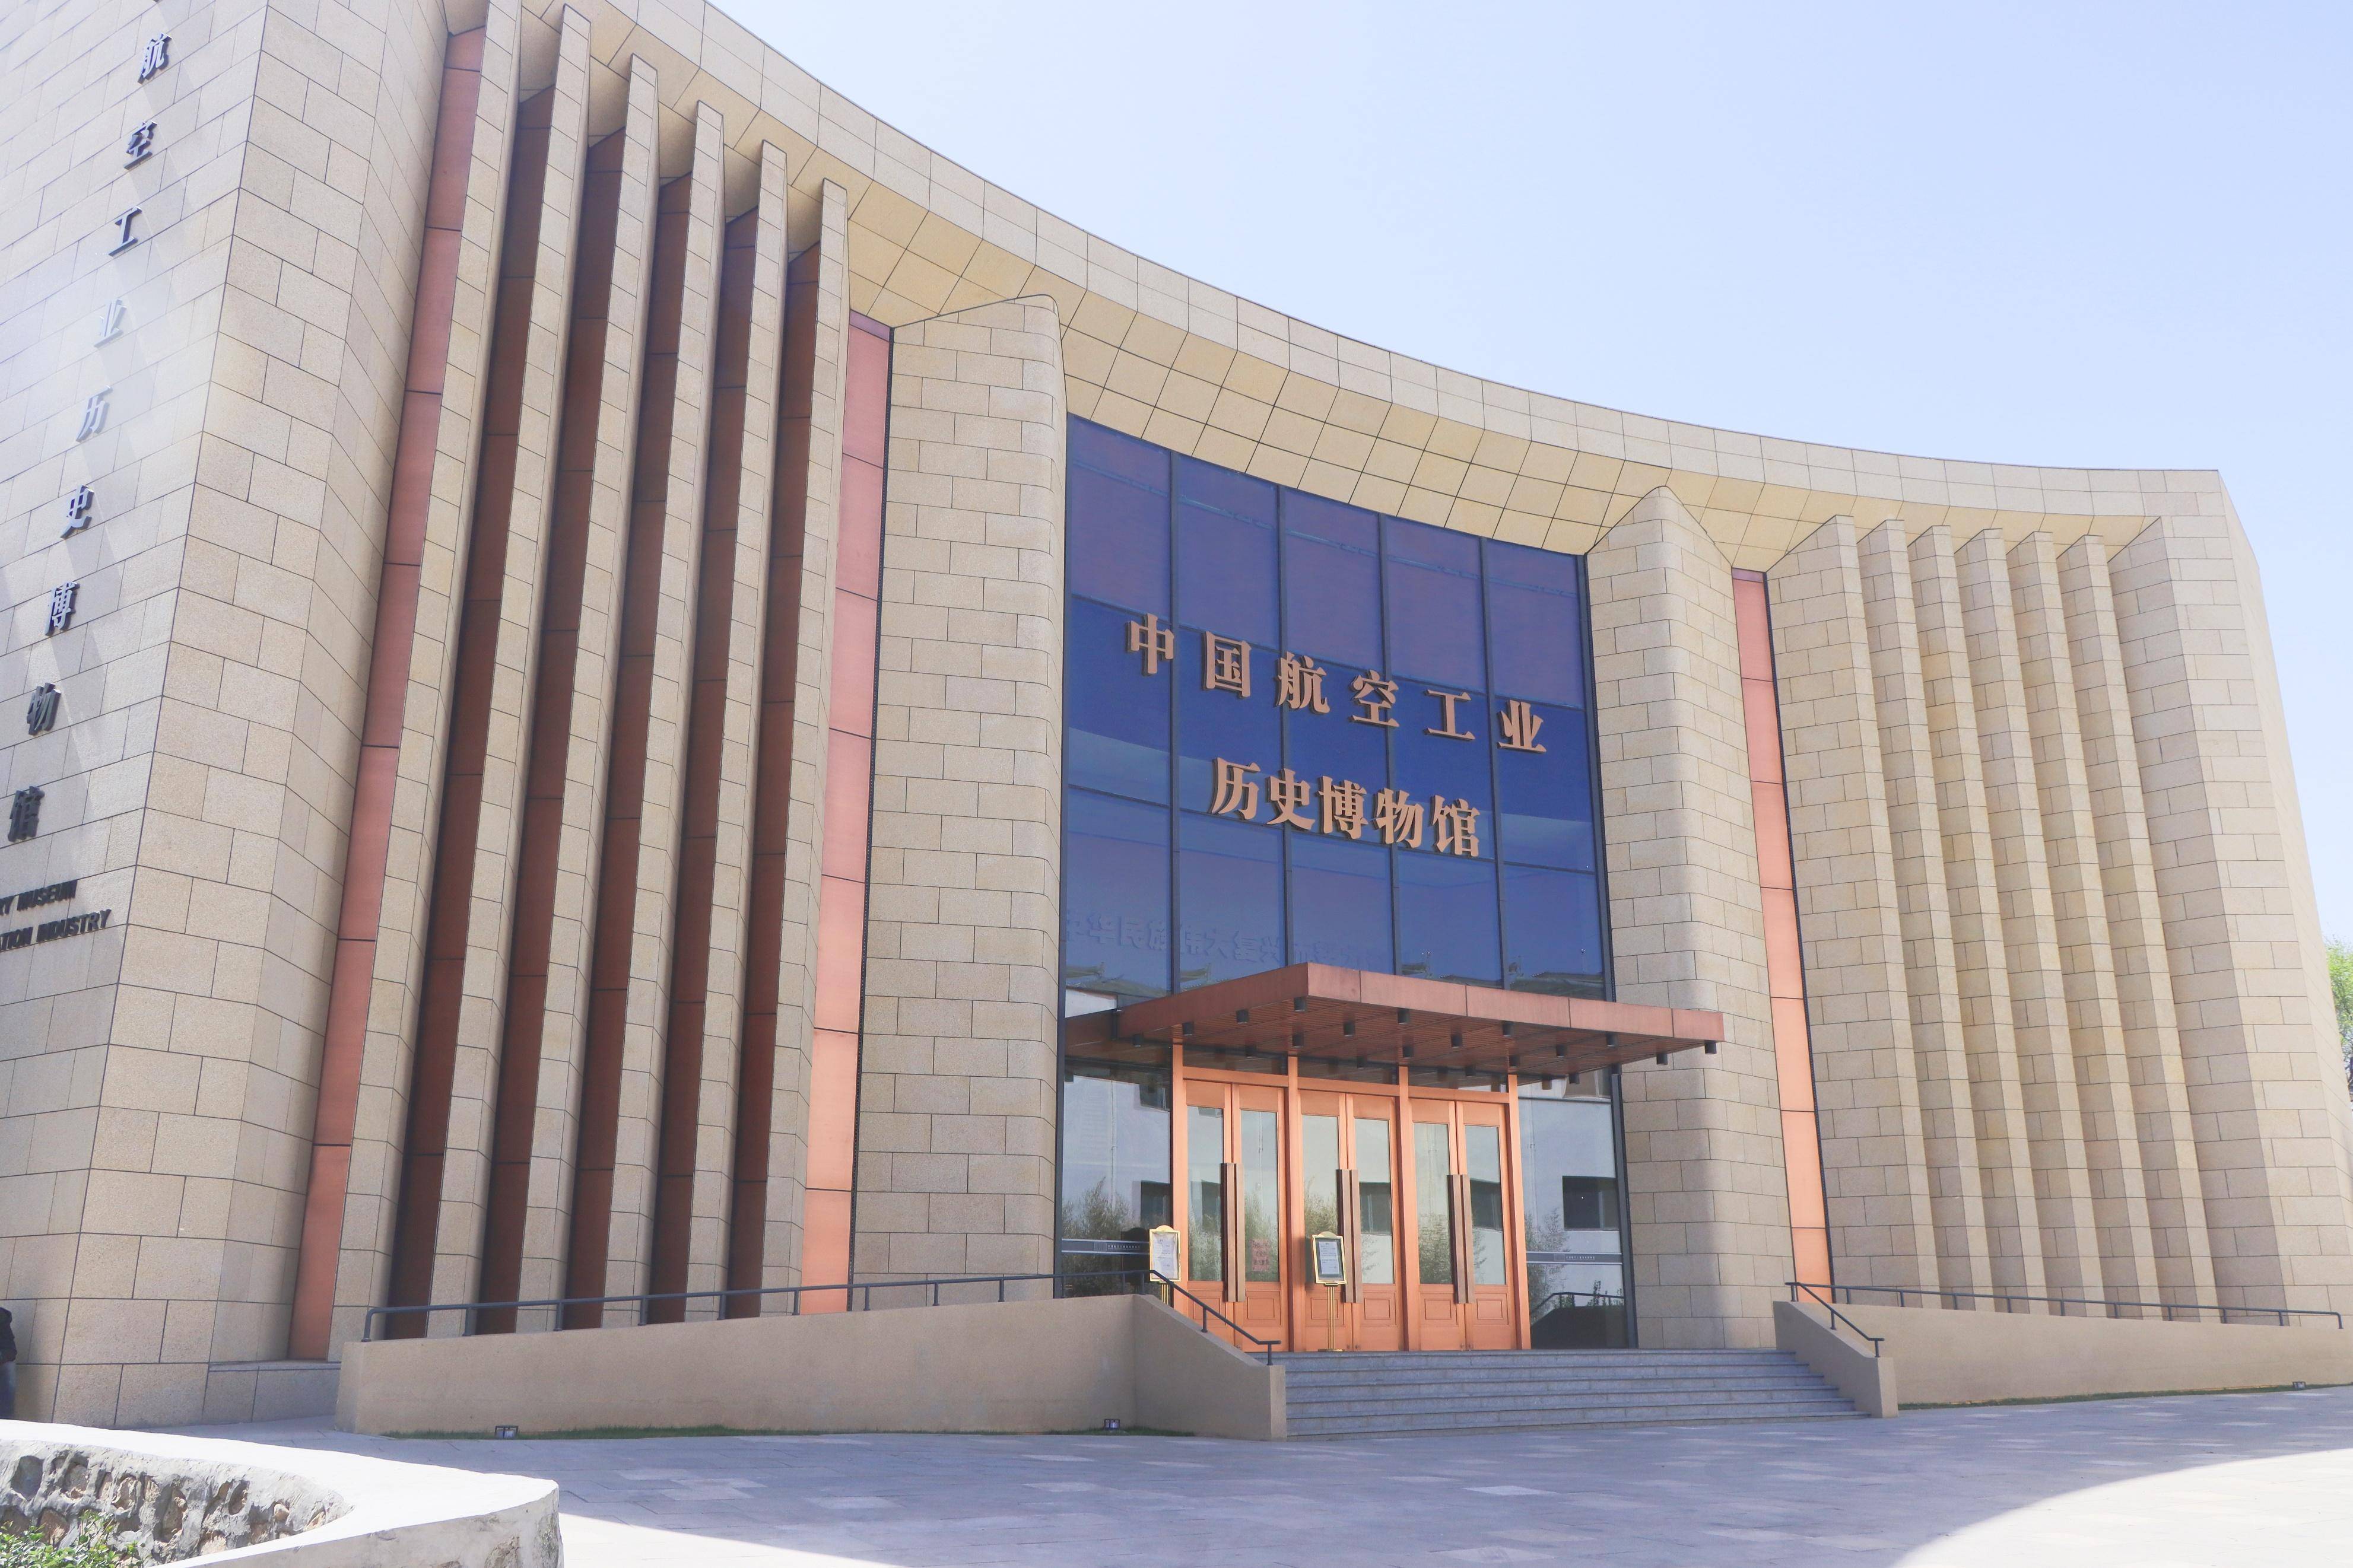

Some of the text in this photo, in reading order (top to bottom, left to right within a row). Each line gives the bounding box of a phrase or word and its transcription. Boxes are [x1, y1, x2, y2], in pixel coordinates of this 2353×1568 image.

[1128, 613, 1546, 752] 中国航空工业
[1209, 756, 1479, 857] 历史博物馆
[17, 880, 78, 911] MUSEUM
[36, 909, 112, 942] INDUSTRY
